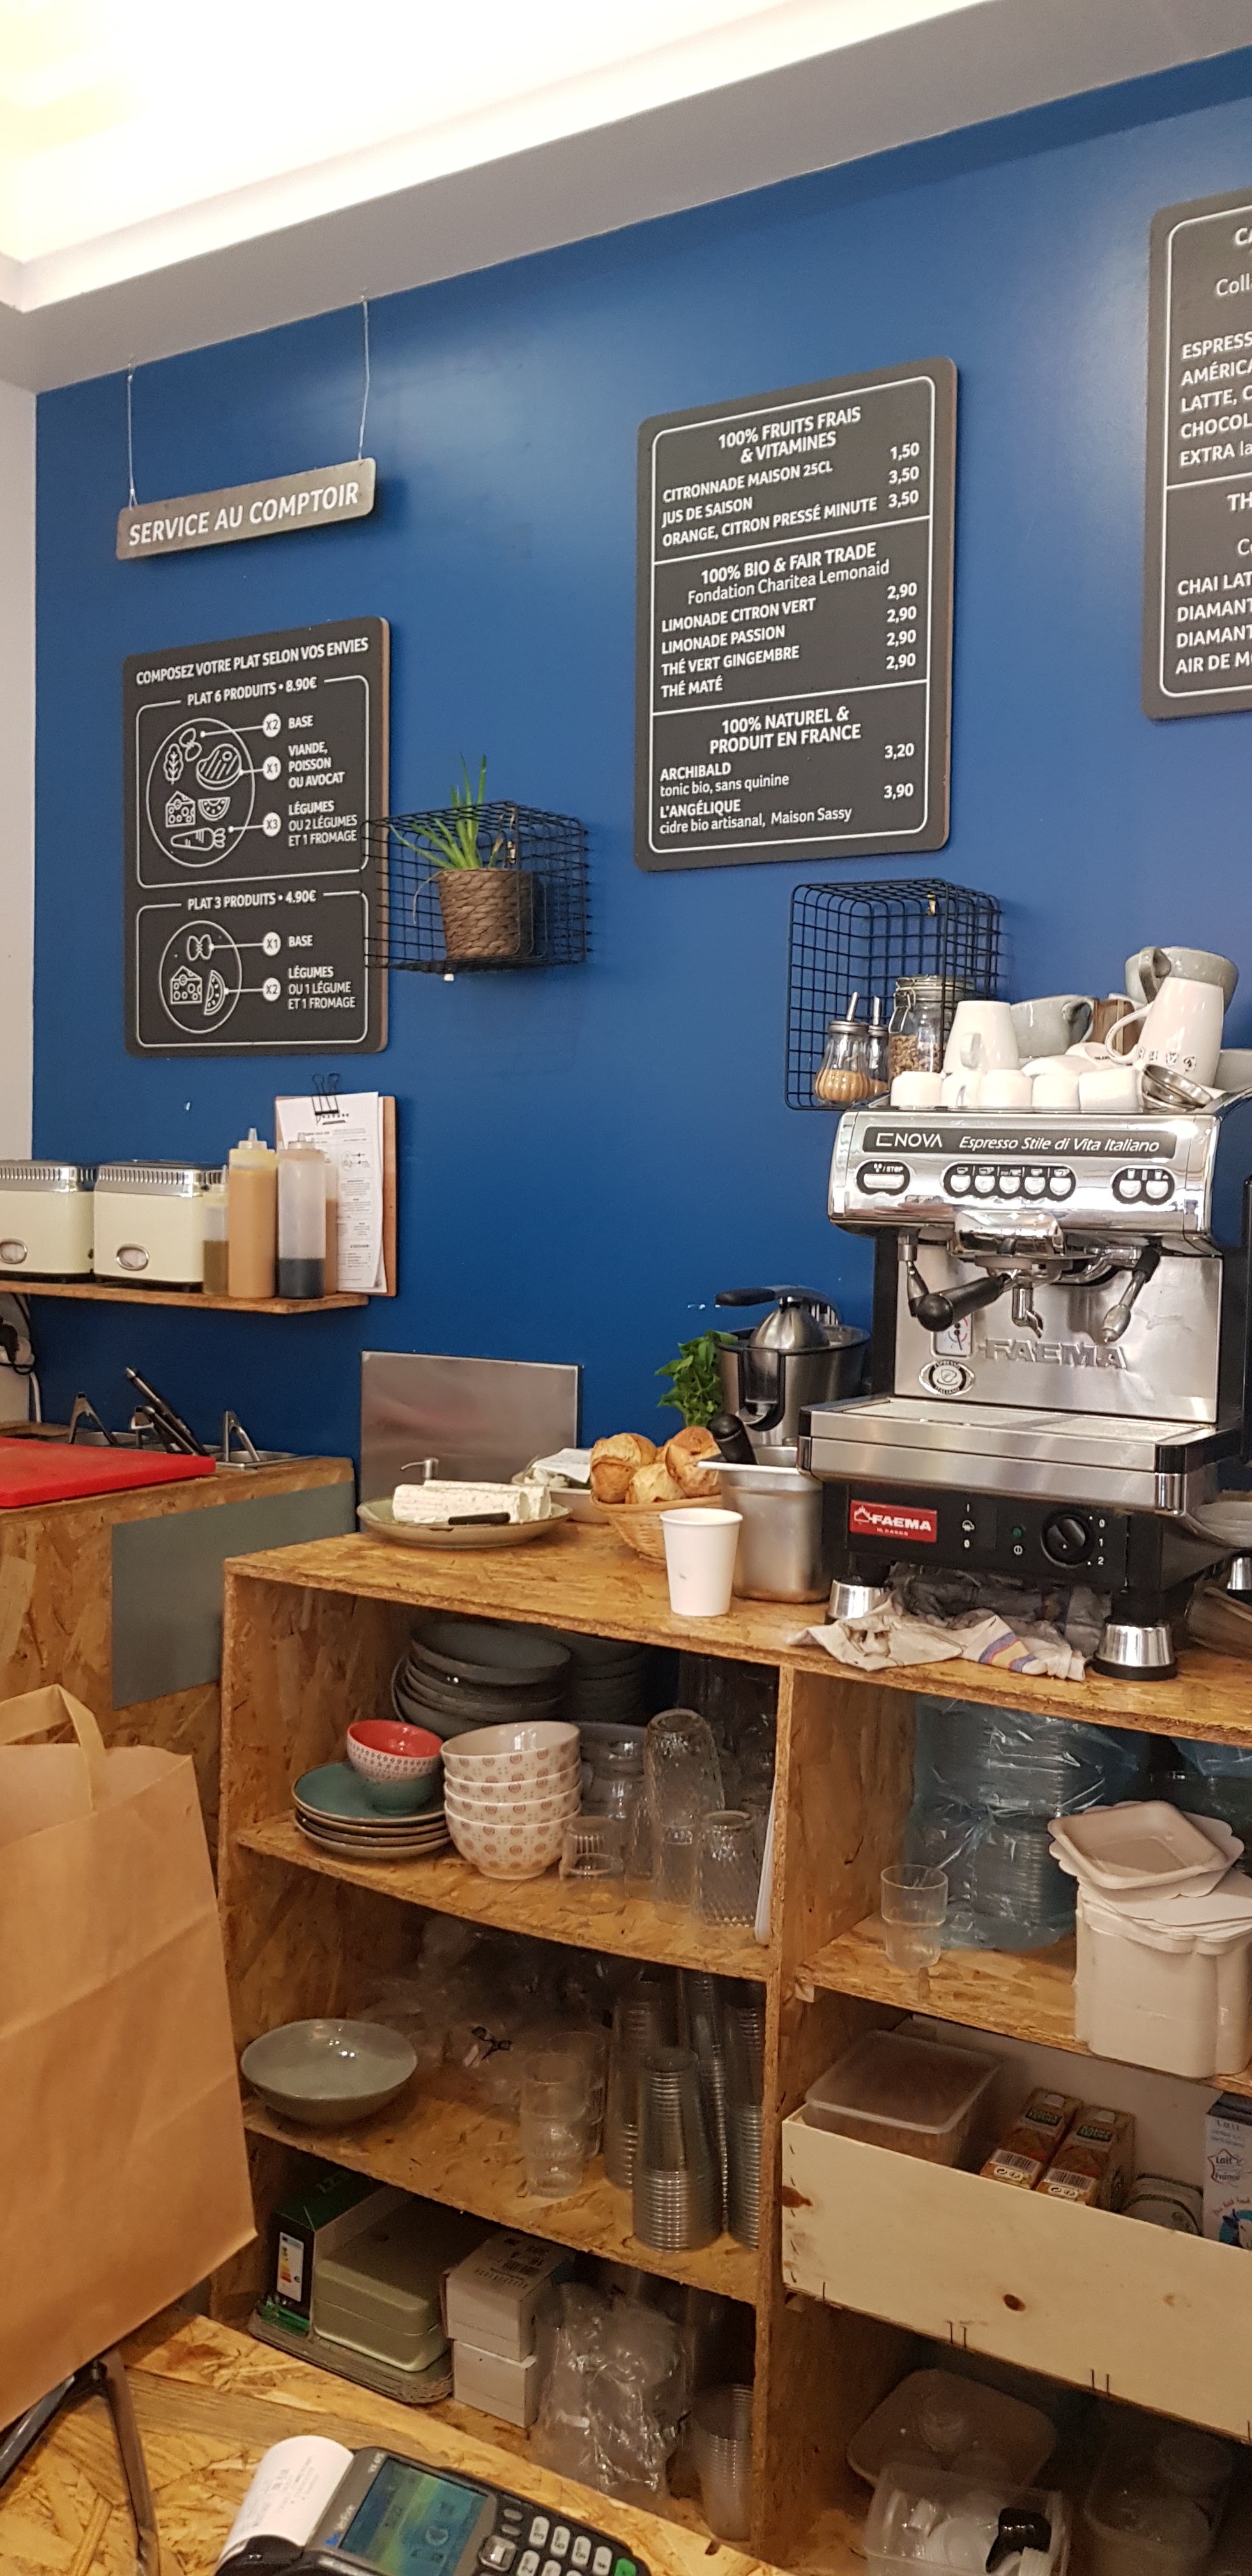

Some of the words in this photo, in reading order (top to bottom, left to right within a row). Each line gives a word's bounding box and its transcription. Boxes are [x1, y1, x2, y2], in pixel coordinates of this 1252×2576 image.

[1216, 273, 1252, 297] Coll
[1180, 388, 1237, 413] LATTE,
[719, 427, 759, 448] 100%
[762, 415, 814, 440] FRUITS
[817, 406, 861, 429] FRAIS
[1180, 413, 1252, 439] CHOCOL
[740, 448, 753, 464] &
[755, 431, 836, 461] VITAMINES
[1180, 443, 1235, 466] EXTRA
[663, 475, 745, 503] CITRONNADE
[747, 464, 800, 487] MAISON
[803, 460, 833, 477] 25CL
[890, 442, 920, 461] 1,50
[661, 509, 683, 528] JUS
[685, 505, 703, 521] DE
[705, 496, 752, 518] SAISON
[889, 466, 919, 484] 3,50
[1226, 491, 1252, 511] TH
[129, 511, 210, 546] SERVICE
[214, 505, 243, 531] AU
[249, 482, 359, 524] COMPTOIR
[662, 525, 719, 547] ORANGE,
[721, 516, 770, 537] CITRON
[773, 503, 821, 528] PRESSÉ
[823, 496, 878, 519] MINUTE
[889, 489, 919, 509] 3,50
[1237, 538, 1252, 556] C
[701, 564, 741, 584] 100%
[744, 560, 770, 578] BIO
[773, 557, 786, 573] &
[790, 551, 821, 571] FAIR
[824, 542, 876, 564] TRADE
[688, 583, 755, 605] Fondation
[758, 574, 816, 594] Charitea
[820, 558, 889, 585] Lemonaid
[1177, 576, 1218, 595] CHAI
[662, 610, 728, 632] LIMONADE
[731, 602, 779, 622] CITRON
[781, 597, 816, 615] VERT
[887, 582, 917, 601] 2,90
[662, 633, 728, 655] LIMONADE
[731, 625, 785, 645] PASSION
[887, 606, 917, 624] 2,90
[136, 664, 195, 685] COMPOSEZ
[195, 658, 232, 676] VOTRE
[233, 654, 261, 670] PLAT
[262, 648, 299, 666] SELON
[300, 643, 325, 660] VOS
[326, 637, 369, 657] ENVIES
[660, 657, 686, 676] THÉ
[688, 656, 721, 673] VERT
[723, 645, 800, 668] GINGEMBRE
[887, 629, 917, 647] 2,90
[1175, 657, 1204, 675] AIR
[1208, 653, 1230, 671] DE
[1235, 651, 1252, 667] M
[660, 680, 686, 698] THÉ
[688, 675, 723, 694] MATÉ
[886, 652, 916, 670] 2,90
[187, 691, 213, 706] PLAT
[214, 689, 222, 702] 6
[224, 682, 277, 701] PRODUITS
[286, 676, 317, 693] 8.90€
[266, 719, 279, 730] X2
[288, 715, 314, 729] BASE
[722, 716, 761, 734] 100%
[765, 708, 833, 730] NATUREL
[836, 706, 850, 721] &
[288, 741, 328, 756] VIANDE,
[710, 733, 774, 755] PRODUIT
[777, 730, 797, 747] EN
[801, 723, 861, 744] FRANCE
[266, 762, 279, 773] X1
[288, 756, 332, 772] POISSON
[660, 762, 731, 781] ARCHIBALD
[885, 742, 915, 760] 3,20
[288, 776, 304, 789] OU
[305, 771, 346, 786] AVOCAT
[660, 782, 690, 797] tonic
[691, 781, 713, 794] bio,
[715, 779, 742, 792] sans
[744, 773, 790, 792] quinine
[883, 783, 914, 800] 3,90
[288, 800, 335, 816] LÉGUMES
[266, 818, 279, 829] X3
[288, 819, 303, 832] OU
[305, 818, 312, 831] 2
[312, 814, 358, 830] LÉGUMES
[659, 820, 689, 834] cidre
[691, 818, 709, 832] bio
[711, 812, 766, 830] artisanal,
[770, 810, 815, 825] Maison
[817, 808, 852, 822] Sassy
[288, 834, 302, 847] ET
[303, 834, 308, 845] 1
[310, 829, 357, 844] FROMAGE
[188, 896, 214, 910] PLAT
[214, 896, 222, 909] 3
[224, 892, 276, 908] PRODUITS
[285, 889, 316, 903] 4.90€
[266, 938, 278, 949] X1
[288, 935, 313, 947] BASE
[288, 965, 334, 979] LÉGUMES
[266, 984, 279, 995] X2
[288, 983, 303, 995] OU
[305, 983, 310, 994] 1
[312, 980, 351, 994] LÉGUME
[288, 998, 301, 1010] ET
[302, 998, 307, 1009] 1
[309, 996, 356, 1009] FROMAGE
[959, 1136, 1019, 1151] Espresso
[1021, 1137, 1051, 1150] Stile
[1054, 1137, 1071, 1150] di
[1074, 1138, 1102, 1151] Vita
[1104, 1138, 1159, 1152] Italiano
[986, 1338, 1127, 1369] FAEMA
[871, 1514, 932, 1532] FAEMA
[1099, 1519, 1105, 1528] 0
[1099, 1538, 1103, 1546] 1
[1097, 1556, 1104, 1565] 2
